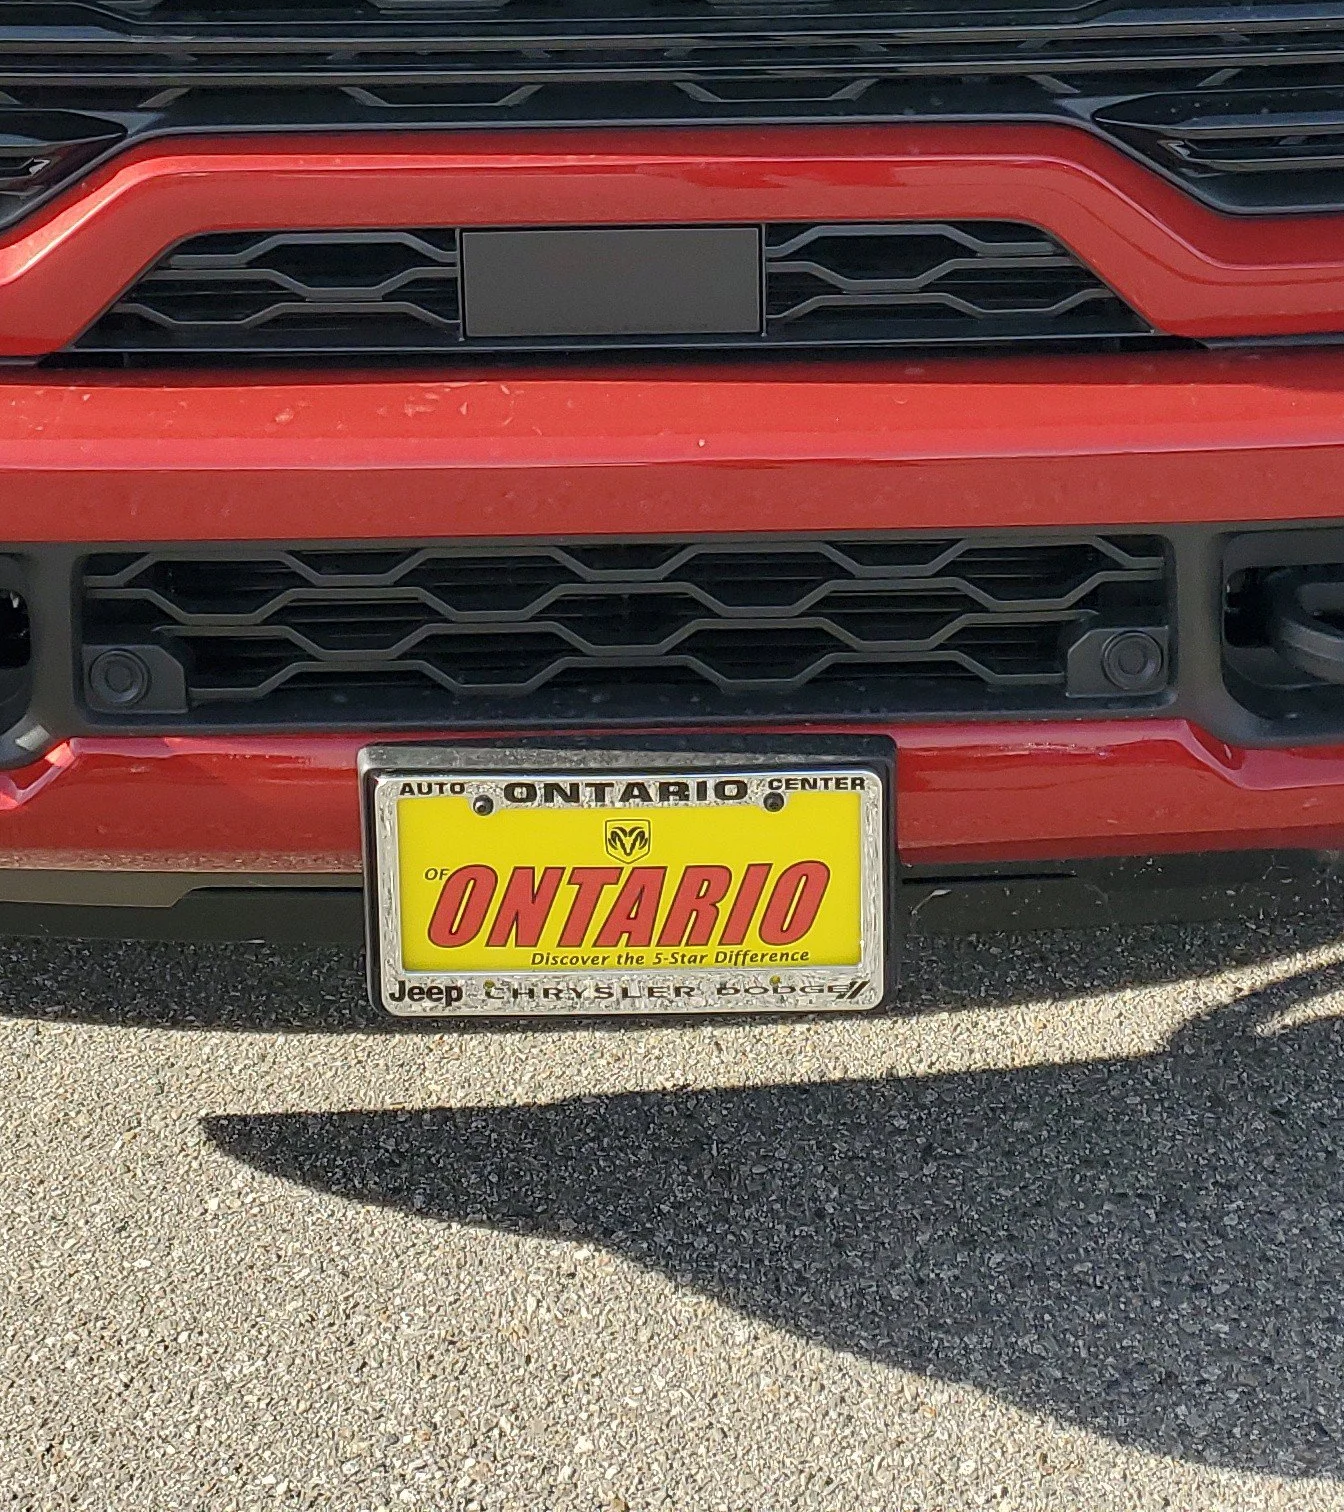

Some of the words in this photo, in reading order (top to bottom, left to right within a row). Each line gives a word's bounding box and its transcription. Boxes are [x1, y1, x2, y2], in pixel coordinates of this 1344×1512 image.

[398, 781, 466, 796] AUTO
[503, 779, 750, 804] ONTARIO
[766, 776, 867, 792] CENTER
[424, 867, 450, 881] OF
[427, 860, 832, 949] ONTARIO
[530, 951, 610, 966] Discover
[616, 951, 646, 965] the
[652, 950, 709, 965] 5-Star
[714, 949, 811, 967] Difference
[388, 979, 464, 1007] Jeep
[484, 985, 697, 1000] CHRYSLER
[716, 984, 852, 997] DODGE
